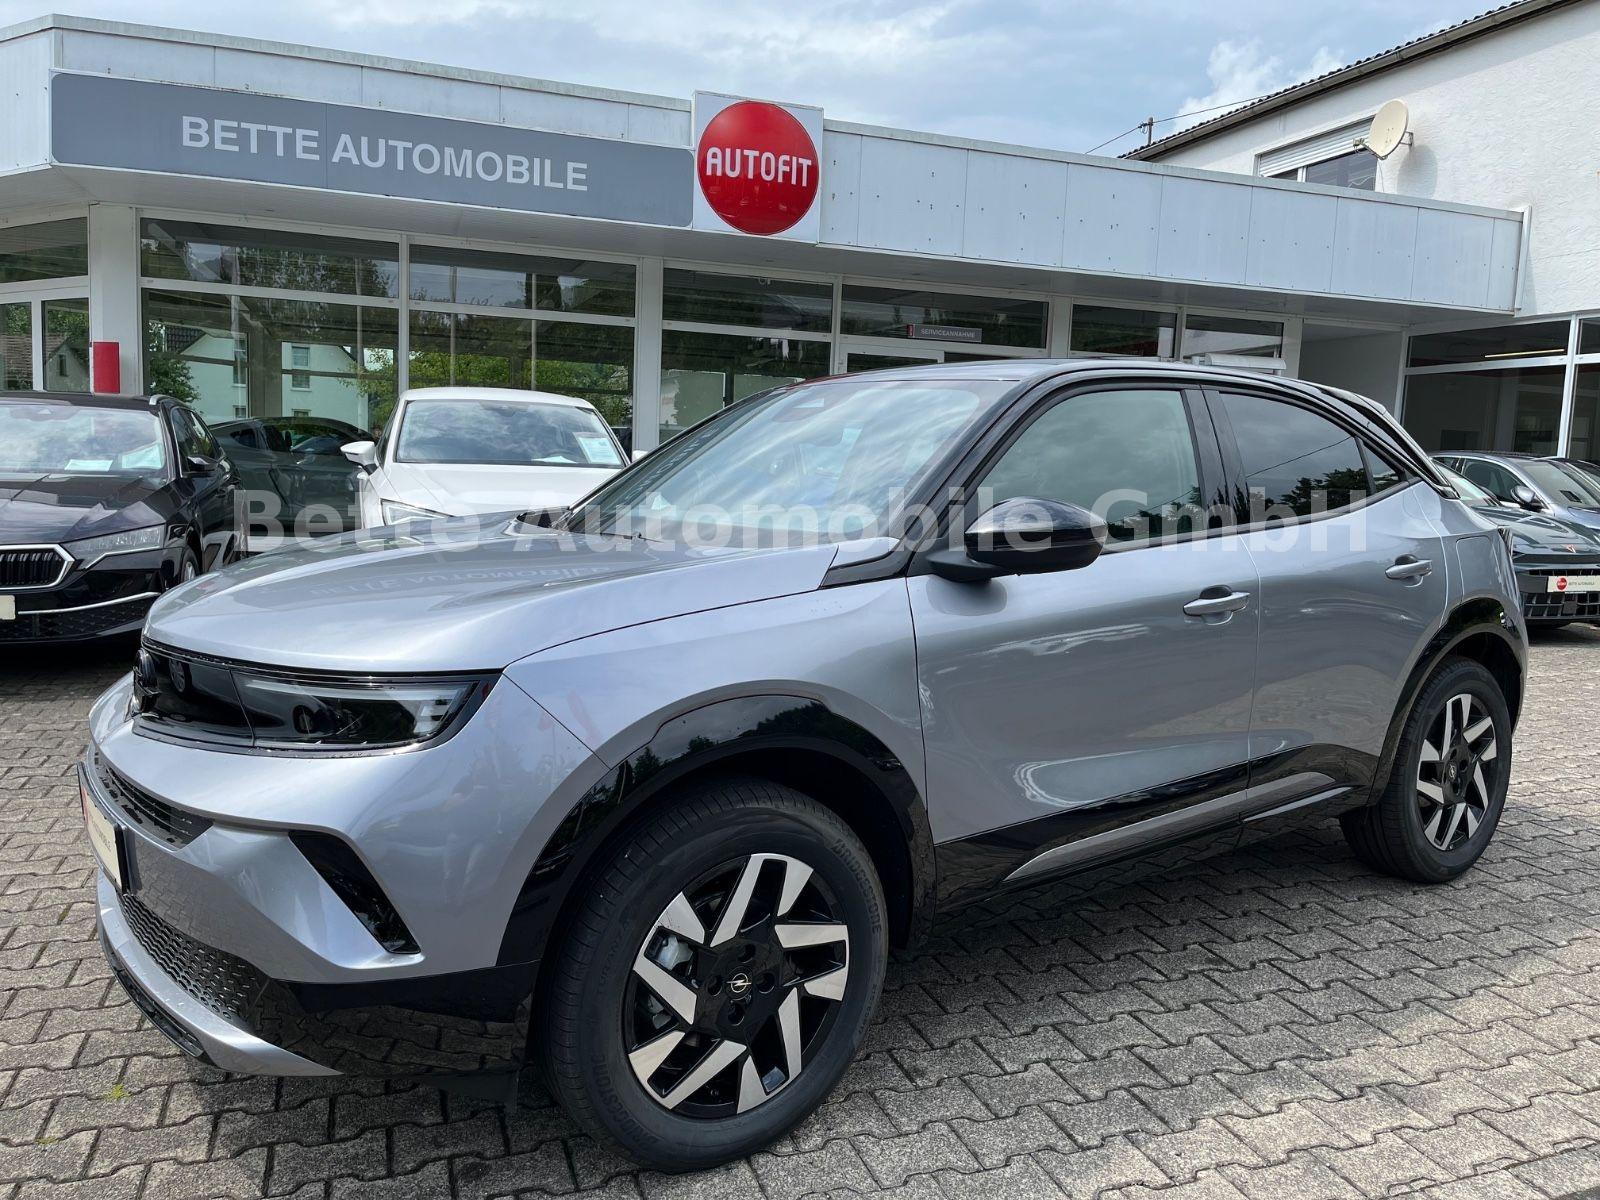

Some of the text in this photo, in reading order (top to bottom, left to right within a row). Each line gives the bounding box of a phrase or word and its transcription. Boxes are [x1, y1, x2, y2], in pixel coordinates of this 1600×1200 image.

[181, 115, 589, 192] BETTE AUTOMOBILE
[706, 147, 812, 187] AUTOFIT
[920, 328, 976, 338] SERVICEANNAHME
[830, 838, 882, 934] BRIDGESTONE
